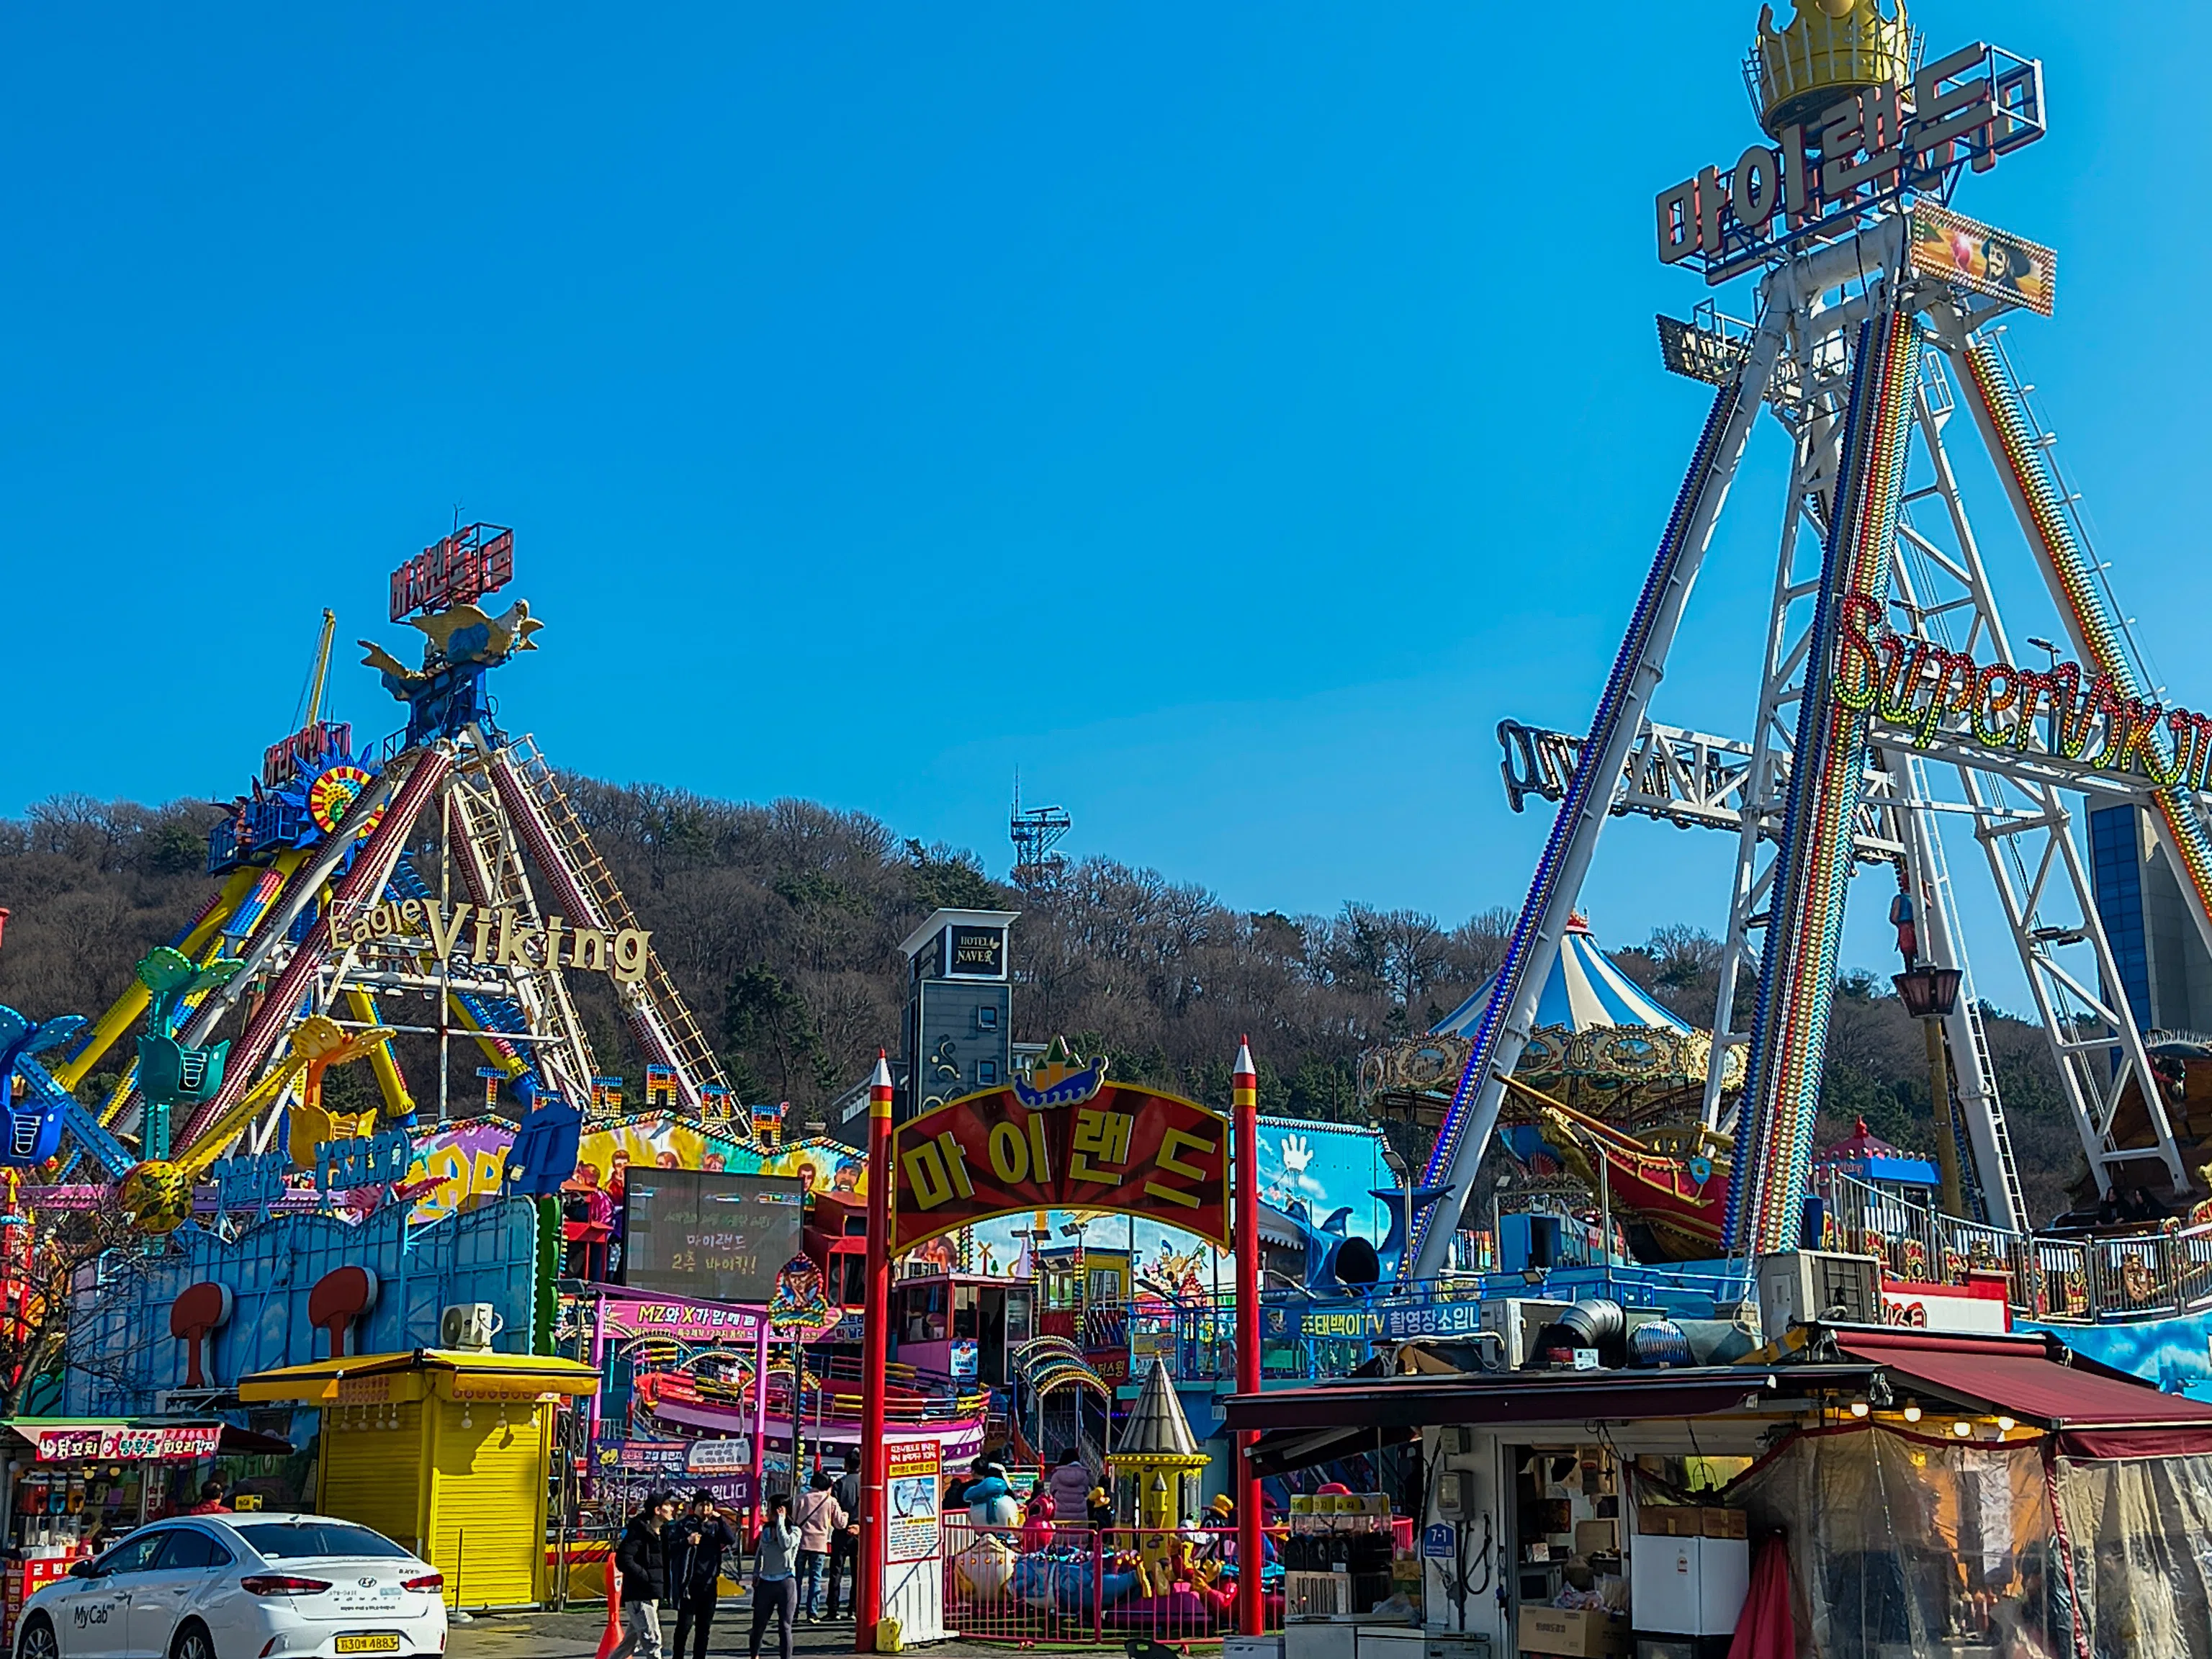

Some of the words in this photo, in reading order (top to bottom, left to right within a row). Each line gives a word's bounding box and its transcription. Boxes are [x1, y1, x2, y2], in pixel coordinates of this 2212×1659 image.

[1656, 42, 1998, 264] 마이랜드
[328, 899, 422, 949] Eagle
[421, 899, 653, 982] Viking
[961, 936, 989, 946] HOTEL
[956, 950, 994, 965] NAVER
[902, 1108, 1215, 1210] 마이랜드
[687, 1233, 746, 1251] 마이랜드
[672, 1250, 696, 1272] 2층
[638, 1304, 679, 1325] MZ와
[682, 1305, 709, 1326] X가
[58, 1438, 98, 1460] 닭꼬치
[120, 1439, 156, 1456] 탕후루
[163, 1439, 217, 1456] 회오리감자
[1431, 1529, 1447, 1542] 7-1
[73, 1603, 108, 1629] MyCab
